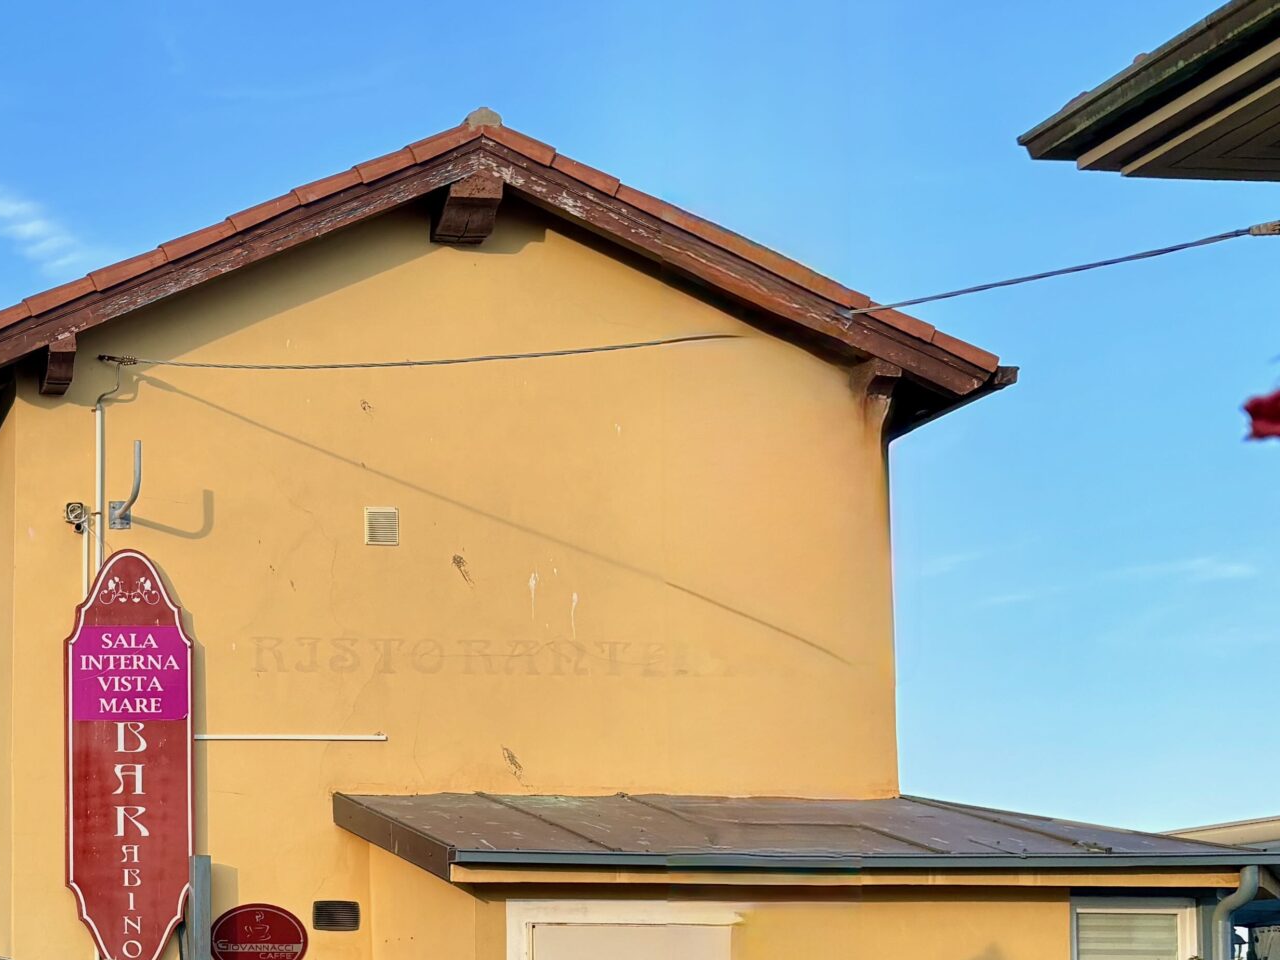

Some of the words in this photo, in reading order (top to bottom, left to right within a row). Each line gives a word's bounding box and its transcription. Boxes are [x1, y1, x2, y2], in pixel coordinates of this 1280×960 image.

[101, 633, 159, 649] SALA
[80, 654, 180, 670] INTERNA
[97, 676, 164, 692] VISTA
[99, 697, 163, 714] MARE
